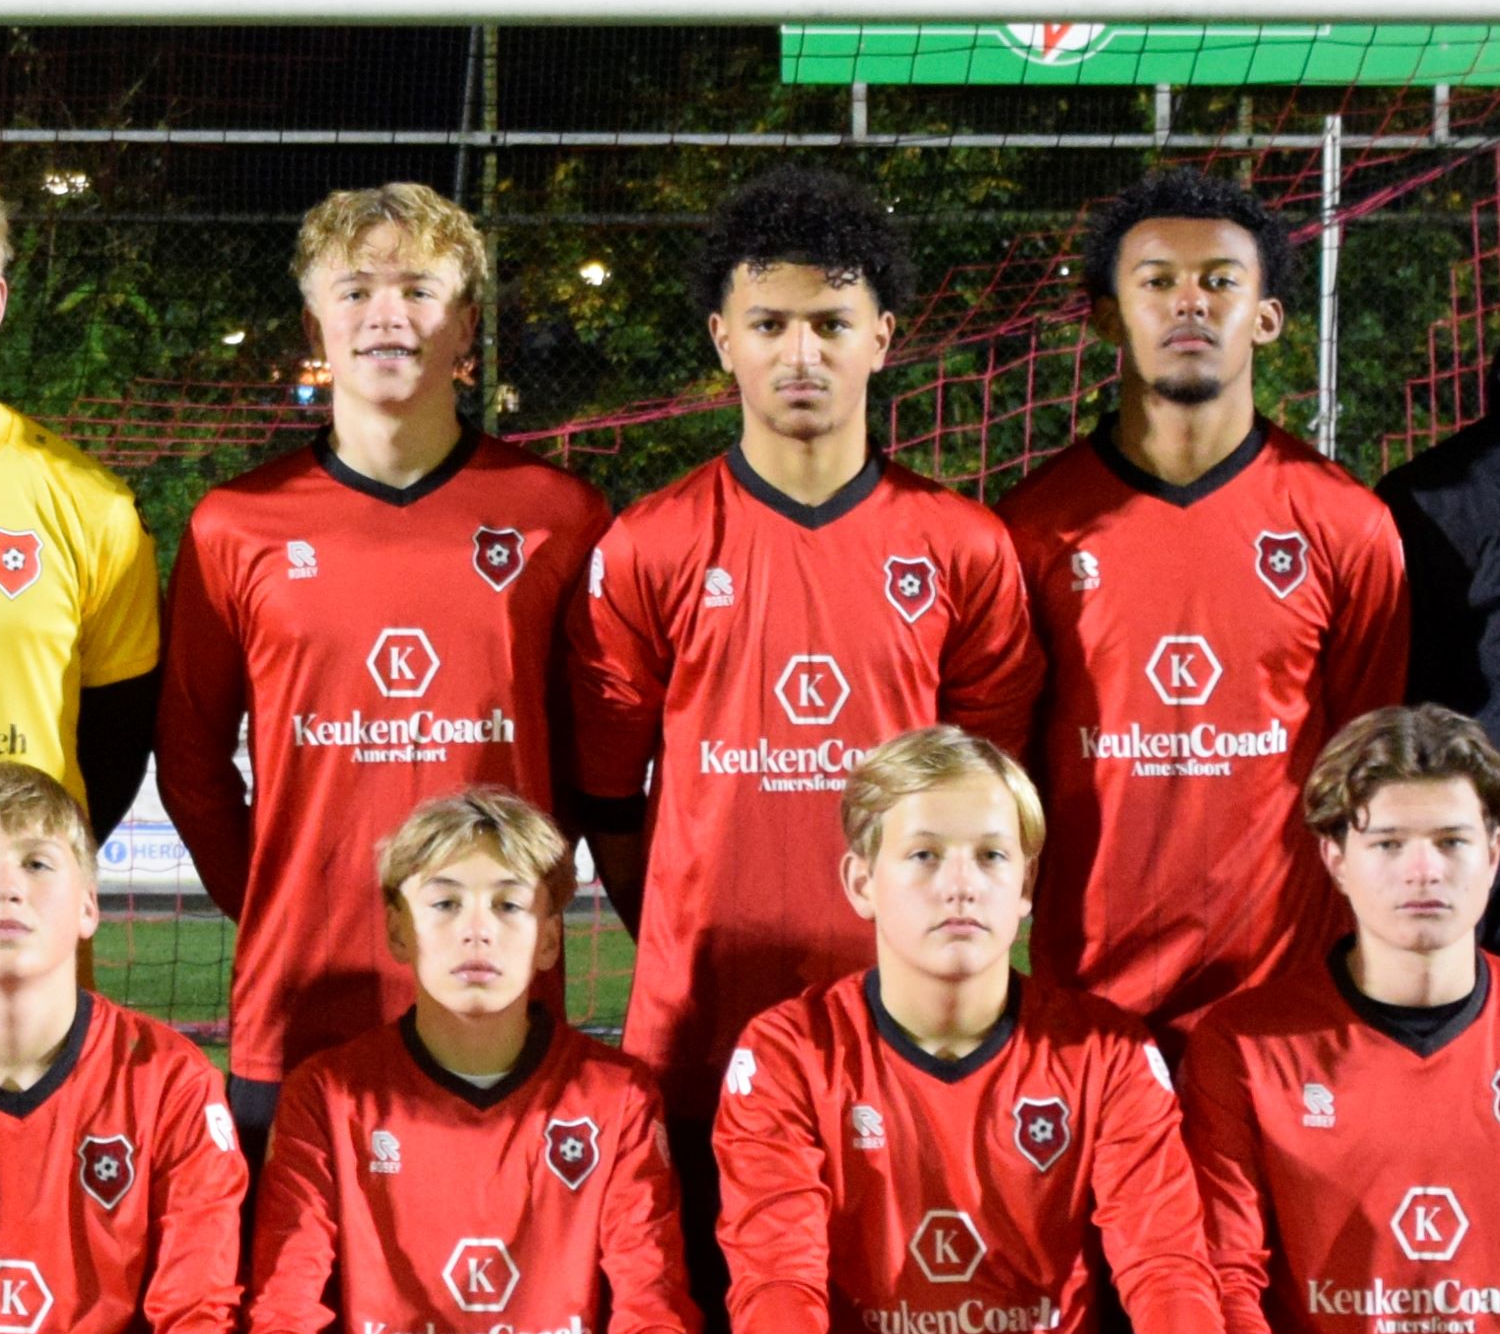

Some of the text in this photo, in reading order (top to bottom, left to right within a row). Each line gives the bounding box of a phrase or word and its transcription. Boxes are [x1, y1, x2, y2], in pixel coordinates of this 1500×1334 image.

[292, 708, 515, 751] KeukenCoach
[1082, 718, 1288, 764] KeukenCoach
[700, 737, 874, 778] KeukenCo
[759, 772, 850, 792] Amersfoor
